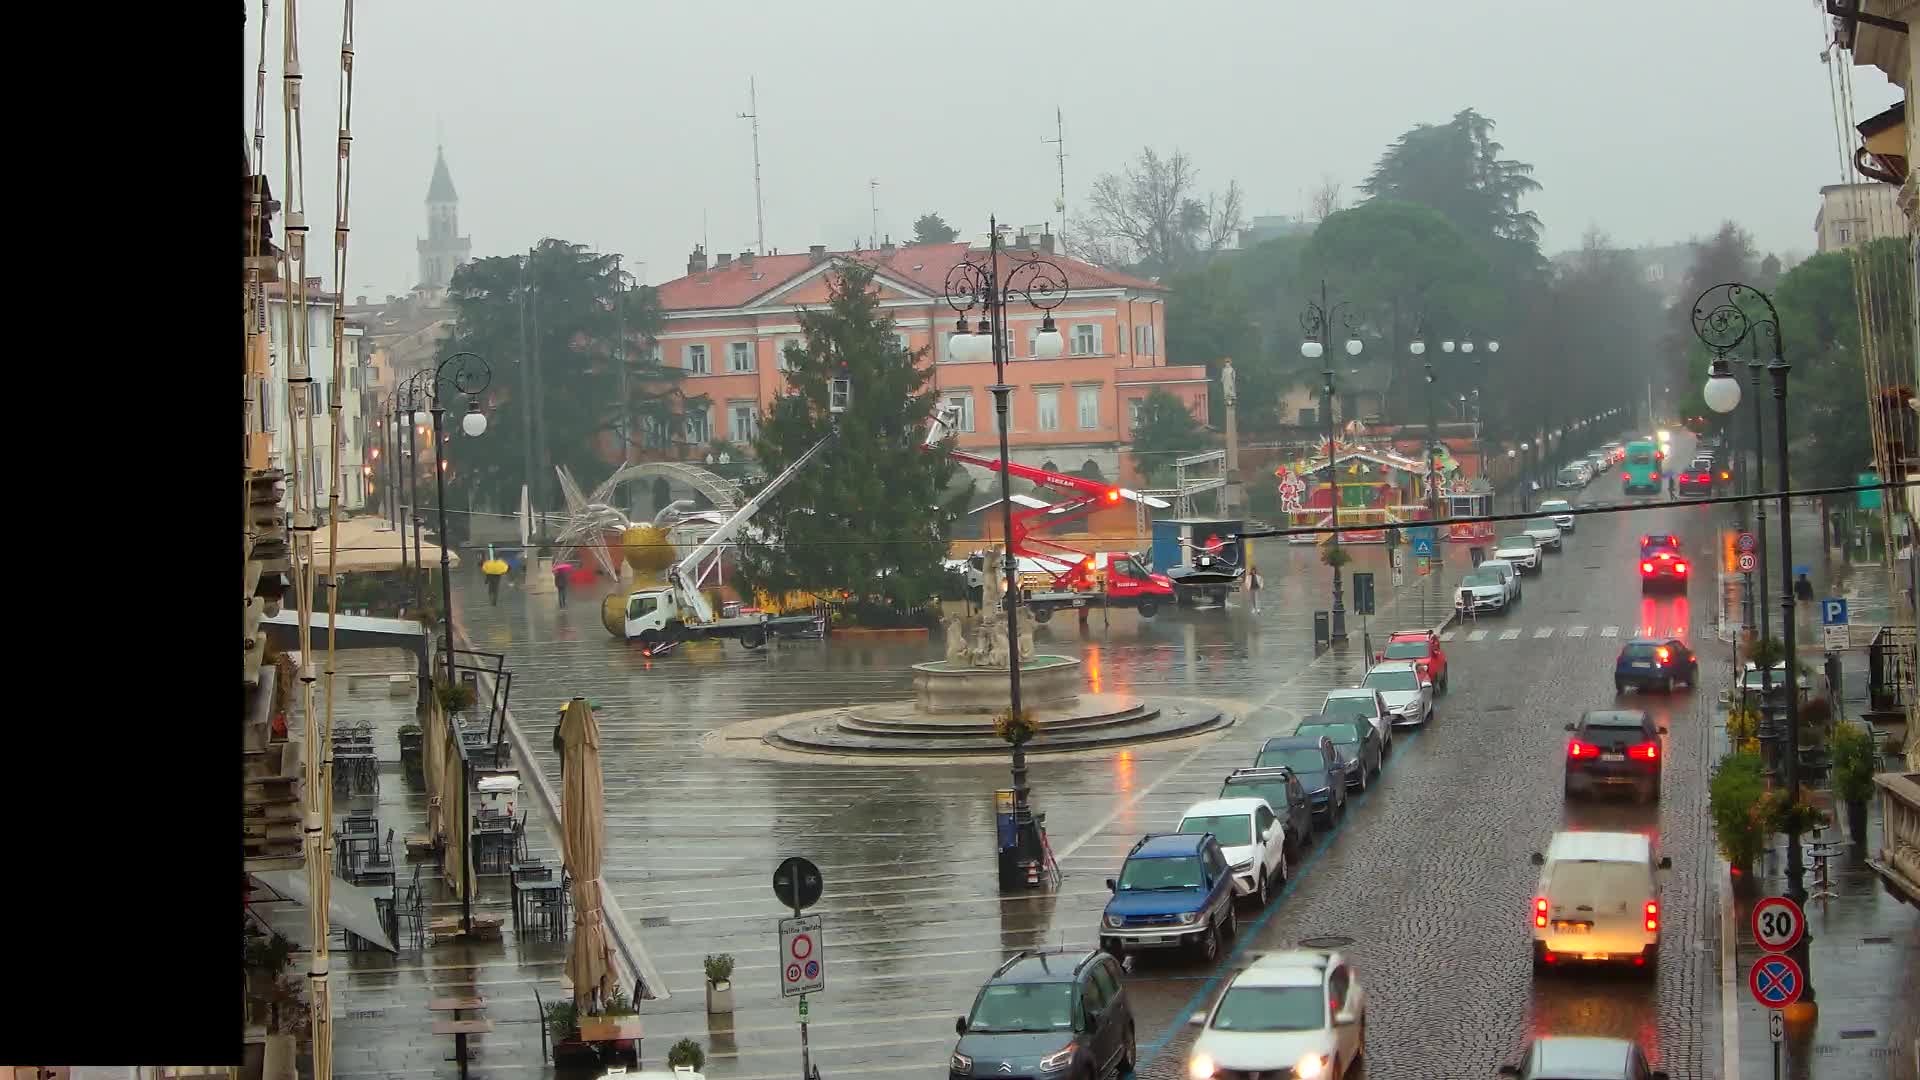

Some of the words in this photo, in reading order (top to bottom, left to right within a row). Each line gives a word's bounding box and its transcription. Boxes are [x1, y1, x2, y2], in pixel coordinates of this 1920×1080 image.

[1742, 557, 1753, 567] 20
[1827, 602, 1842, 622] P
[1762, 911, 1792, 938] 30
